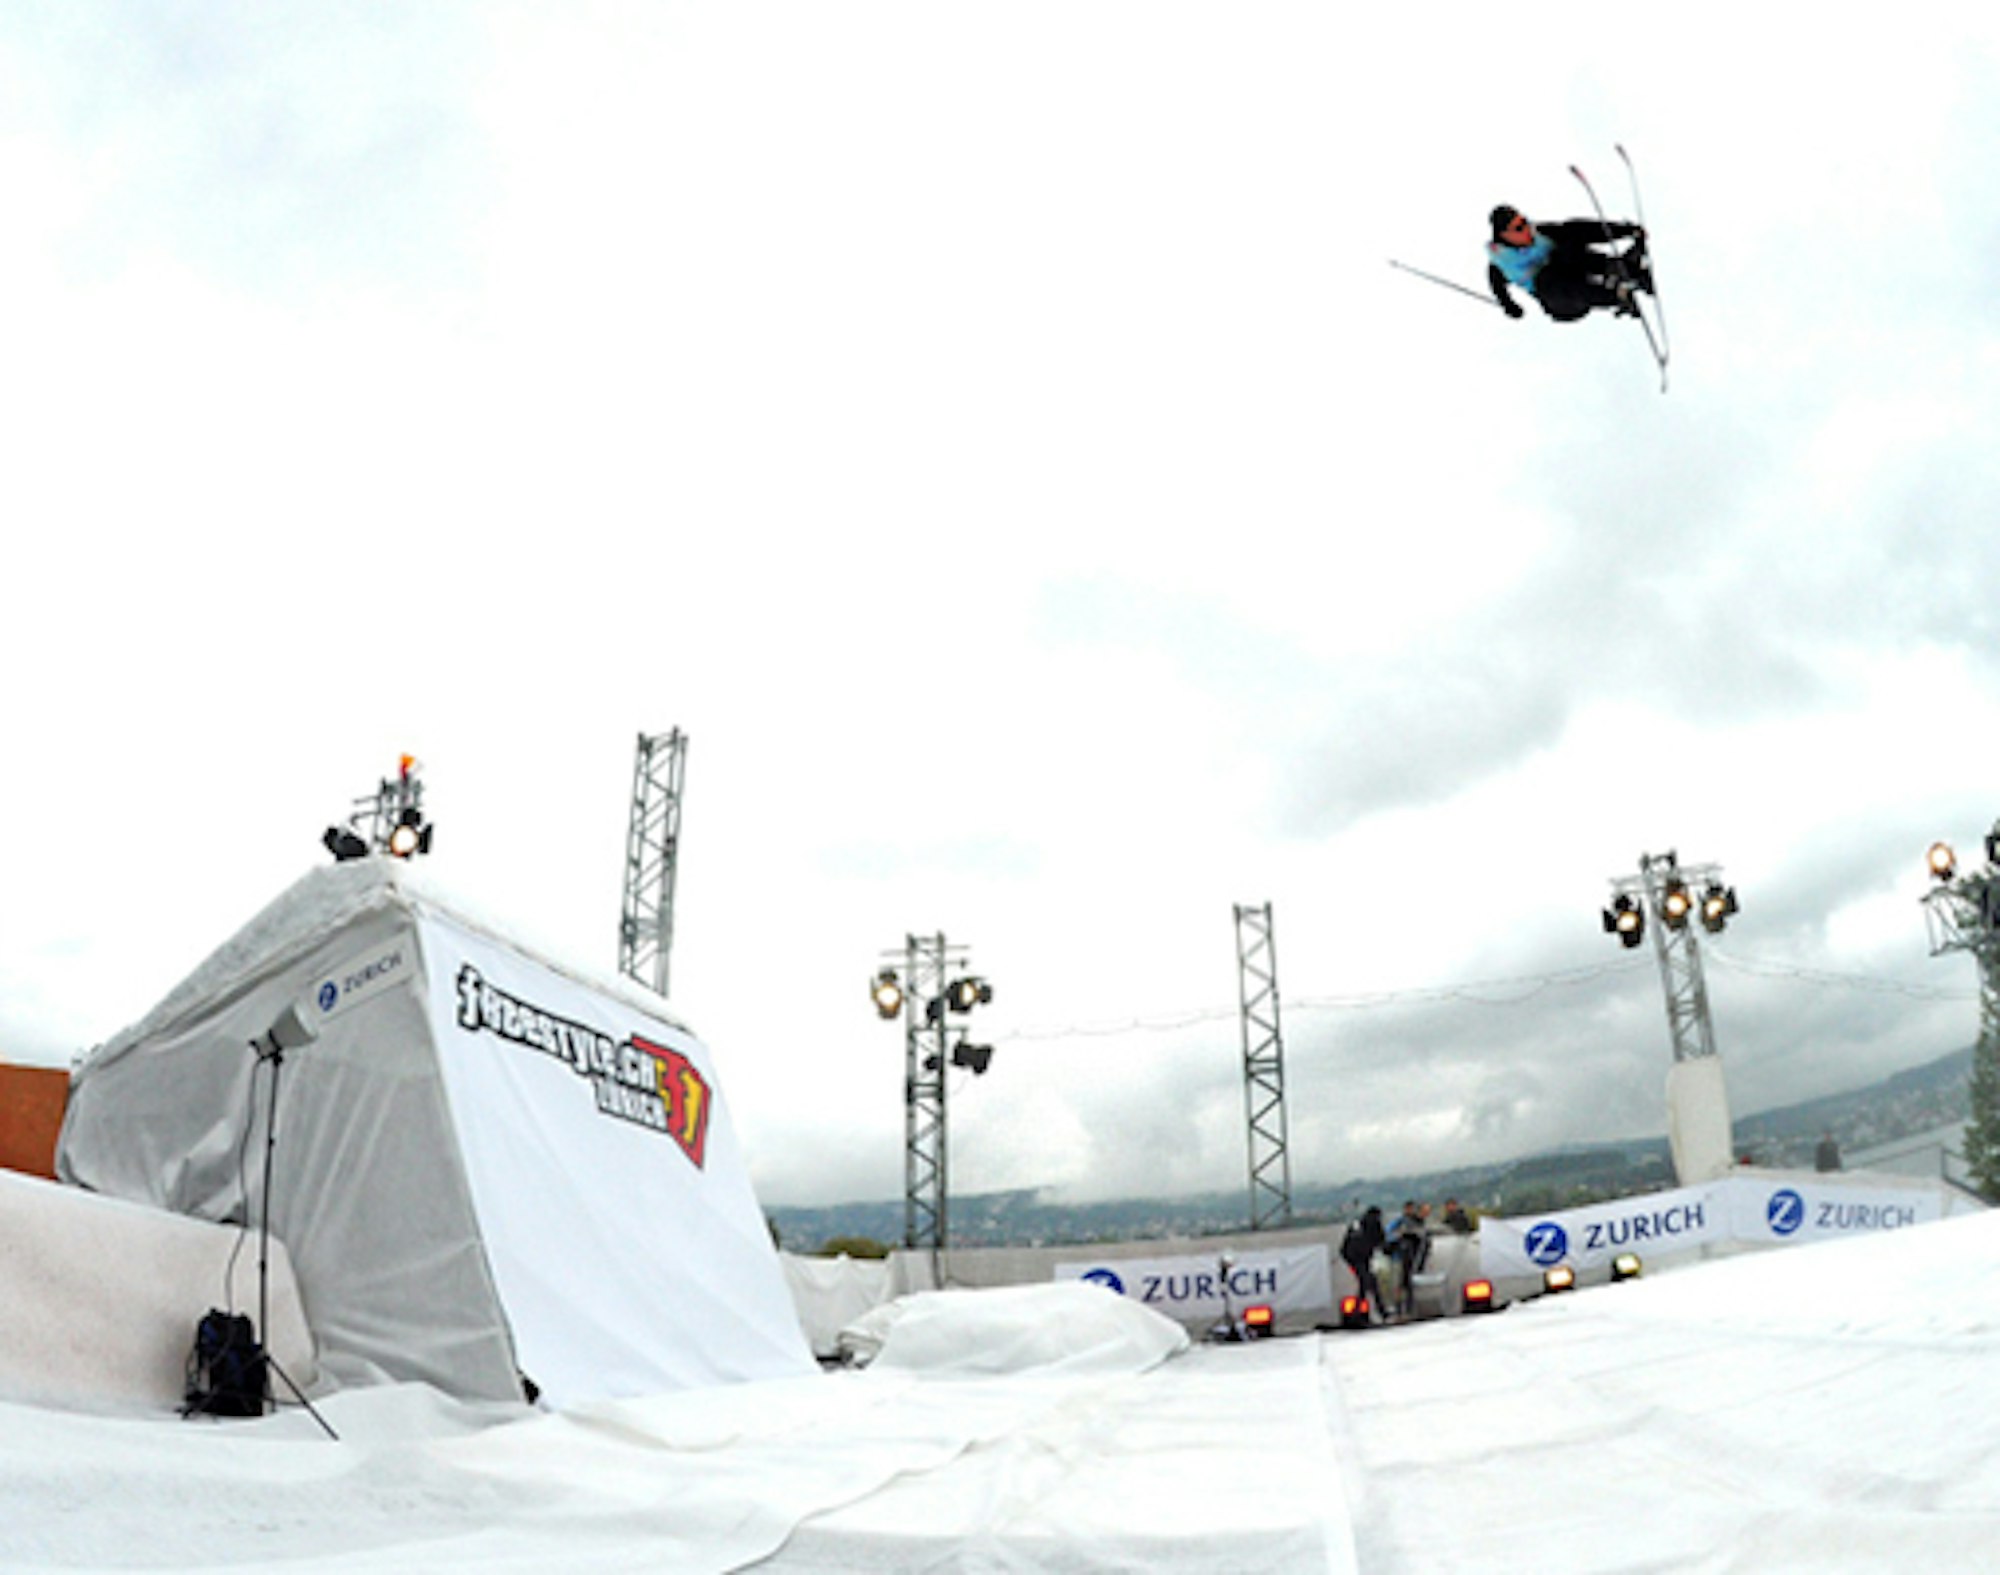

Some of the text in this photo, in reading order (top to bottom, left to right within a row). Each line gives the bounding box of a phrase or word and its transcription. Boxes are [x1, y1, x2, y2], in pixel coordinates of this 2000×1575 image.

[1584, 1203, 1705, 1249] ZURICH
[1815, 1202, 1915, 1229] ZURICH
[1141, 1268, 1277, 1302] ZURCH
